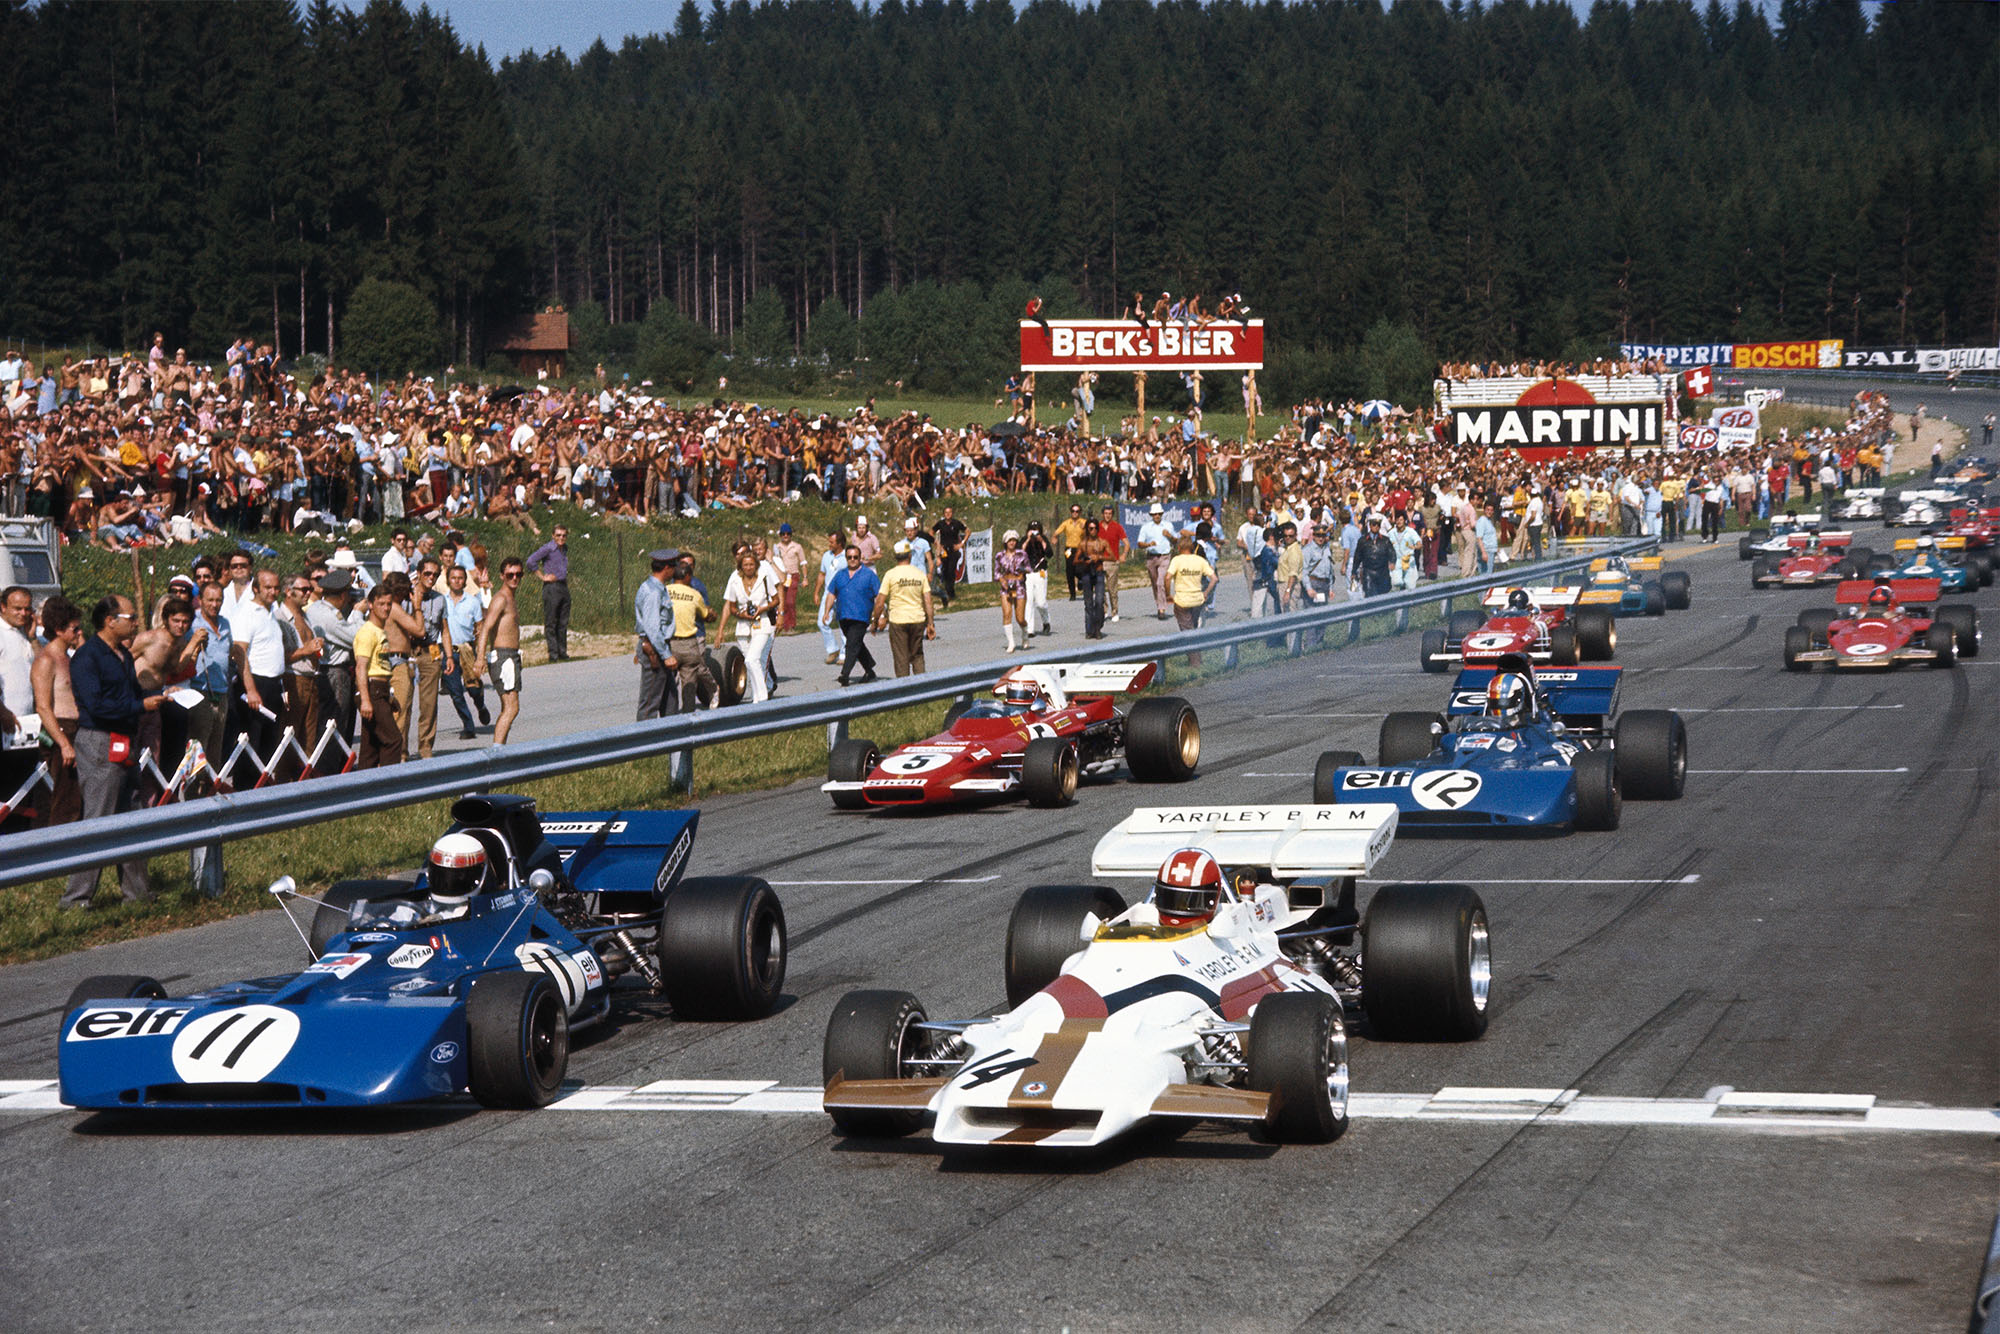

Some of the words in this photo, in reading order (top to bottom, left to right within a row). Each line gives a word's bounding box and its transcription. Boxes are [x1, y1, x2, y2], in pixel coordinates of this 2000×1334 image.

[1158, 328, 1236, 356] BIER
[1620, 345, 1733, 365] SEMPERIT
[1735, 344, 1817, 368] BOSCH
[1456, 407, 1656, 444] MARTINI
[1722, 410, 1752, 427] STP
[1684, 428, 1716, 447] STP
[1480, 638, 1497, 647] 4
[1856, 645, 1877, 653] 2
[902, 755, 936, 770] 5
[1345, 771, 1412, 788] elf
[1422, 771, 1480, 807] 12
[1156, 811, 1273, 824] YARDLEY
[659, 834, 690, 888] GOODYEAR
[389, 953, 409, 966] GOOD
[412, 947, 432, 959] YEAR
[581, 956, 597, 972] elf
[1195, 954, 1240, 982] YARDLEY
[76, 1008, 185, 1038] elf
[189, 1013, 278, 1069] 11
[436, 1044, 454, 1060] Ford
